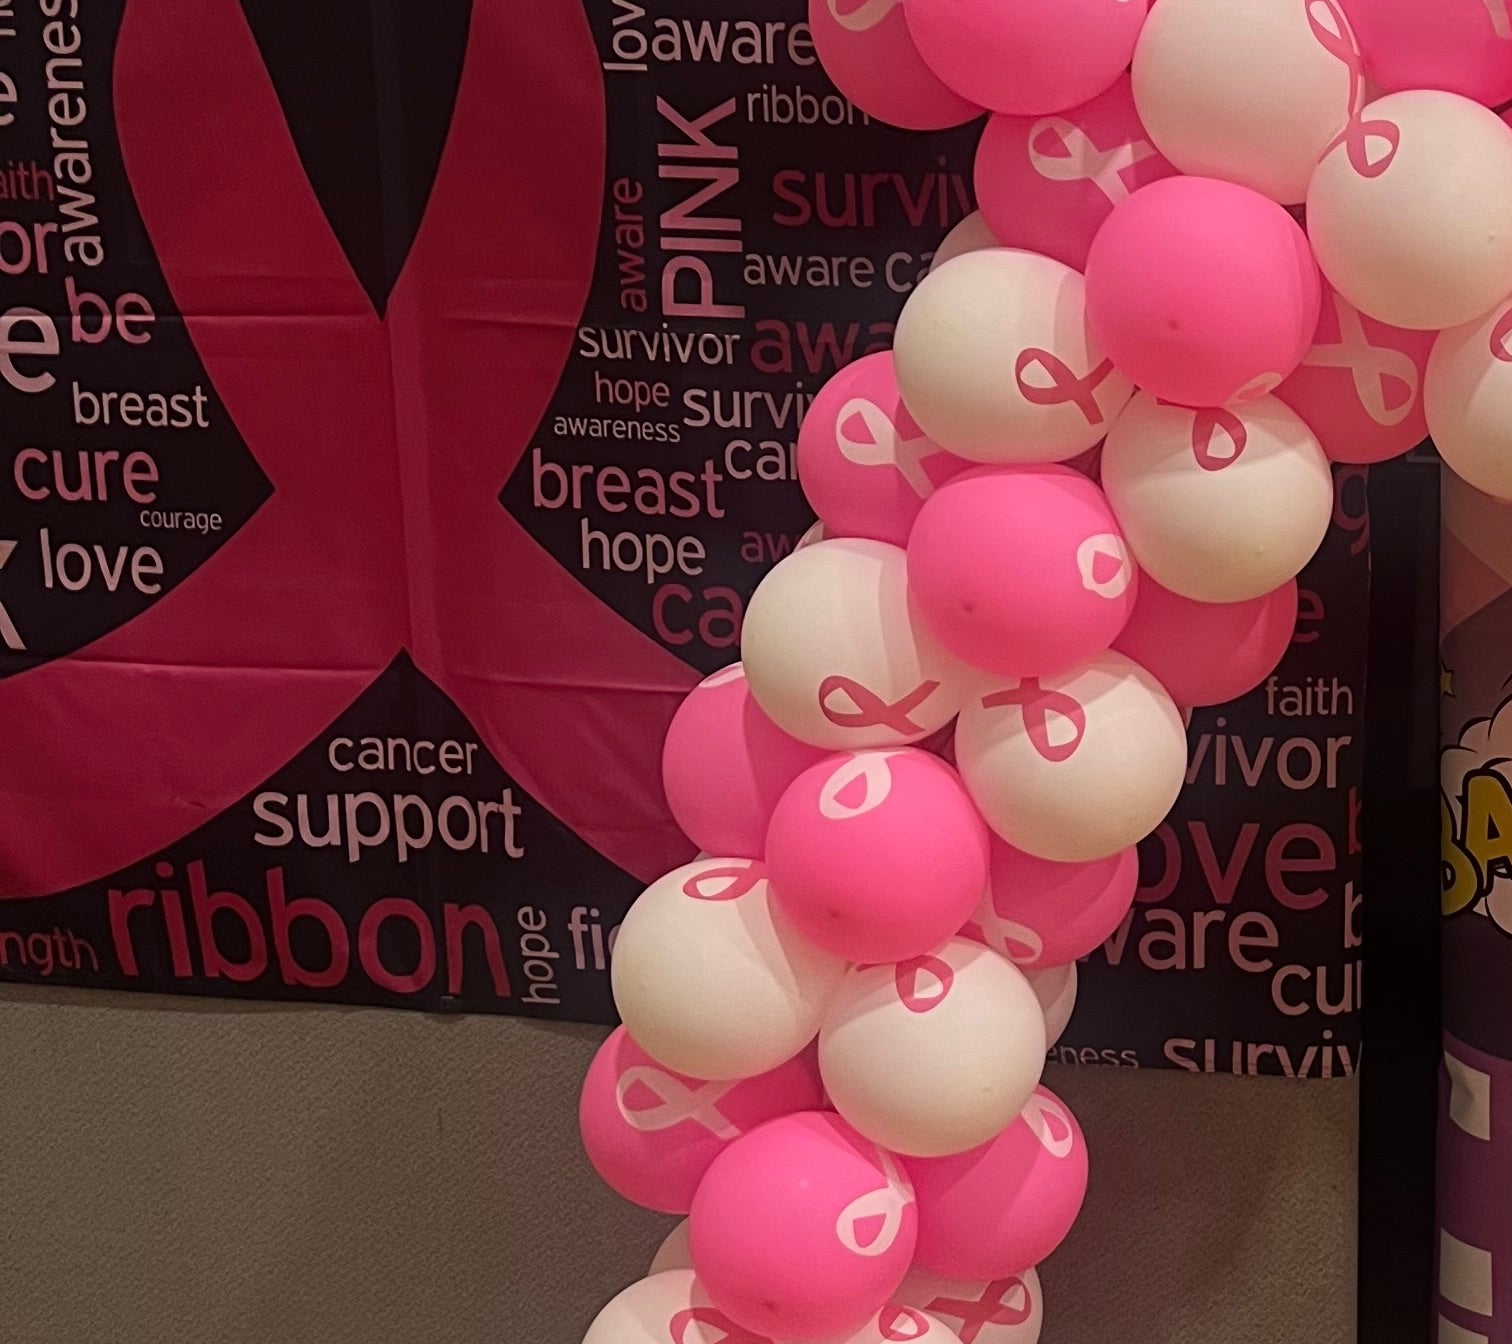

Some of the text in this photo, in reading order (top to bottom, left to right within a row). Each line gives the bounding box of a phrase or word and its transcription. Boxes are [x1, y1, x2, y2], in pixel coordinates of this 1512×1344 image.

[656, 96, 746, 320] PINK
[772, 156, 974, 229] survi
[614, 177, 647, 312] aware
[743, 253, 875, 288] aware
[65, 275, 156, 345] be
[578, 323, 741, 365] survivor
[72, 381, 210, 428] breast
[594, 371, 671, 412] hope
[683, 382, 813, 429] survi
[553, 413, 681, 443] awareness
[14, 447, 160, 504] cure
[532, 448, 726, 519] breast
[139, 508, 223, 535] courage
[580, 517, 707, 584] hope
[40, 527, 164, 595] love
[1265, 675, 1354, 717] faith
[328, 733, 478, 777] cancer
[253, 786, 525, 864] support
[1134, 819, 1337, 911] ove
[0, 926, 98, 977] ngth
[107, 860, 512, 1000] ribbon
[521, 905, 560, 1006] hope
